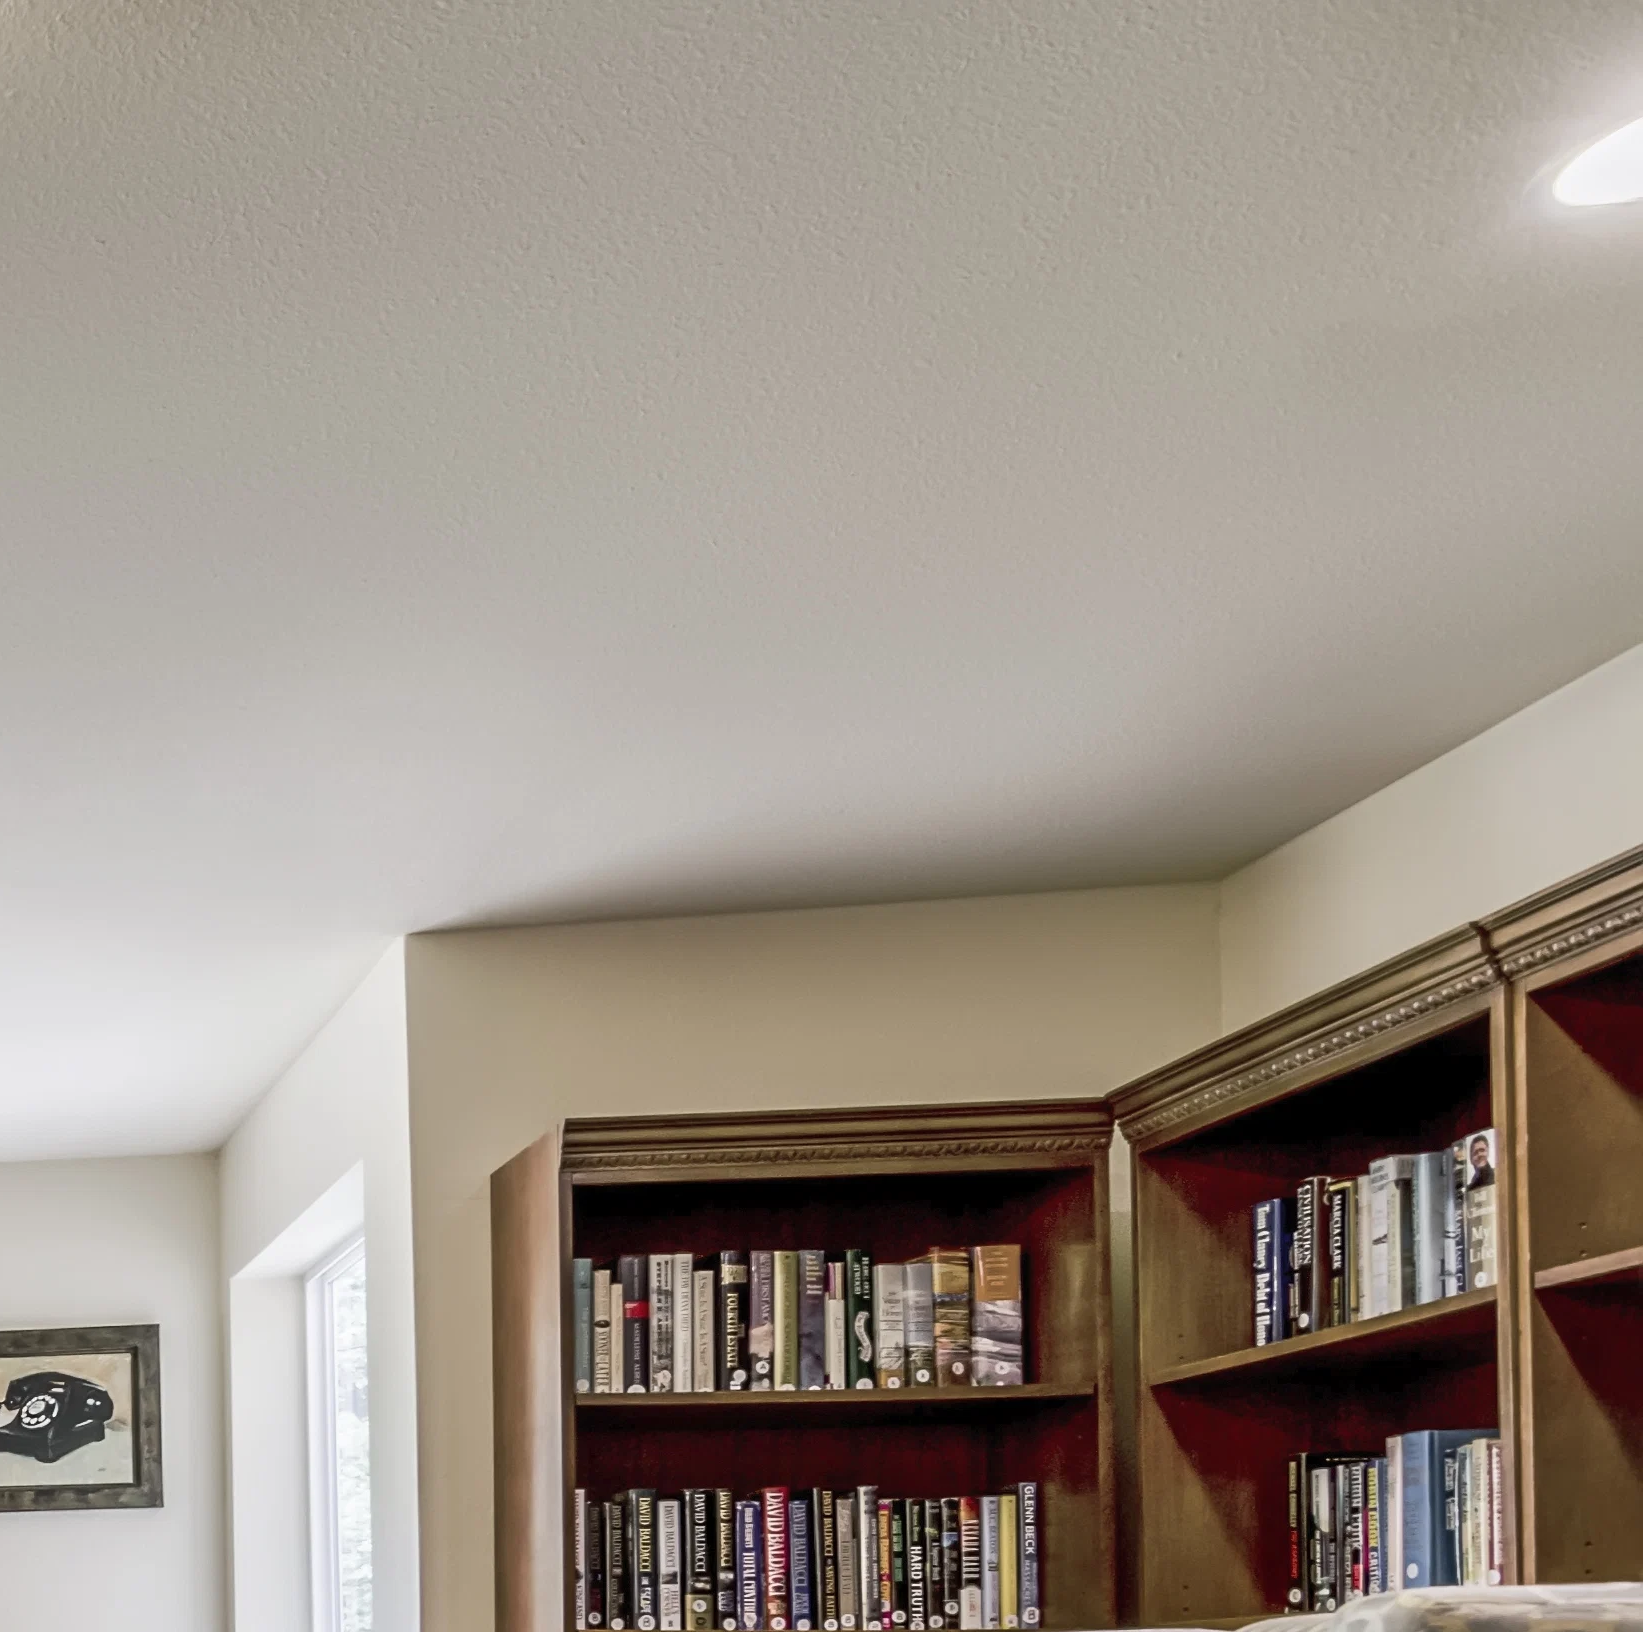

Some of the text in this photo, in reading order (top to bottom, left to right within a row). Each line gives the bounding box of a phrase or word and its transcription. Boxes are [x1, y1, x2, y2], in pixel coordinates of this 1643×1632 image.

[1254, 1205, 1271, 1313] Tom Clancy Debt of
[1302, 1185, 1311, 1264] CIVILISATION
[1332, 1195, 1341, 1269] MARCIA CLARK
[726, 1293, 738, 1368] FOURTH ESTATE
[639, 1497, 651, 1572] DAVID BALDACCI
[664, 1505, 676, 1568] DAVID BALDACCI
[694, 1494, 706, 1572] DAVID BALDACCI
[720, 1492, 732, 1567] DAVID BALDACCI
[766, 1492, 785, 1596] DAVID BALDACCI
[792, 1505, 806, 1586] DAVID BALDACCI
[823, 1491, 835, 1594] DAVID BALDACCI SAVING
[1024, 1486, 1035, 1554] GLENN BECK
[742, 1552, 756, 1577] TOTAL
[910, 1546, 924, 1621] HARD TRUTH
[963, 1556, 980, 1579] BARR
